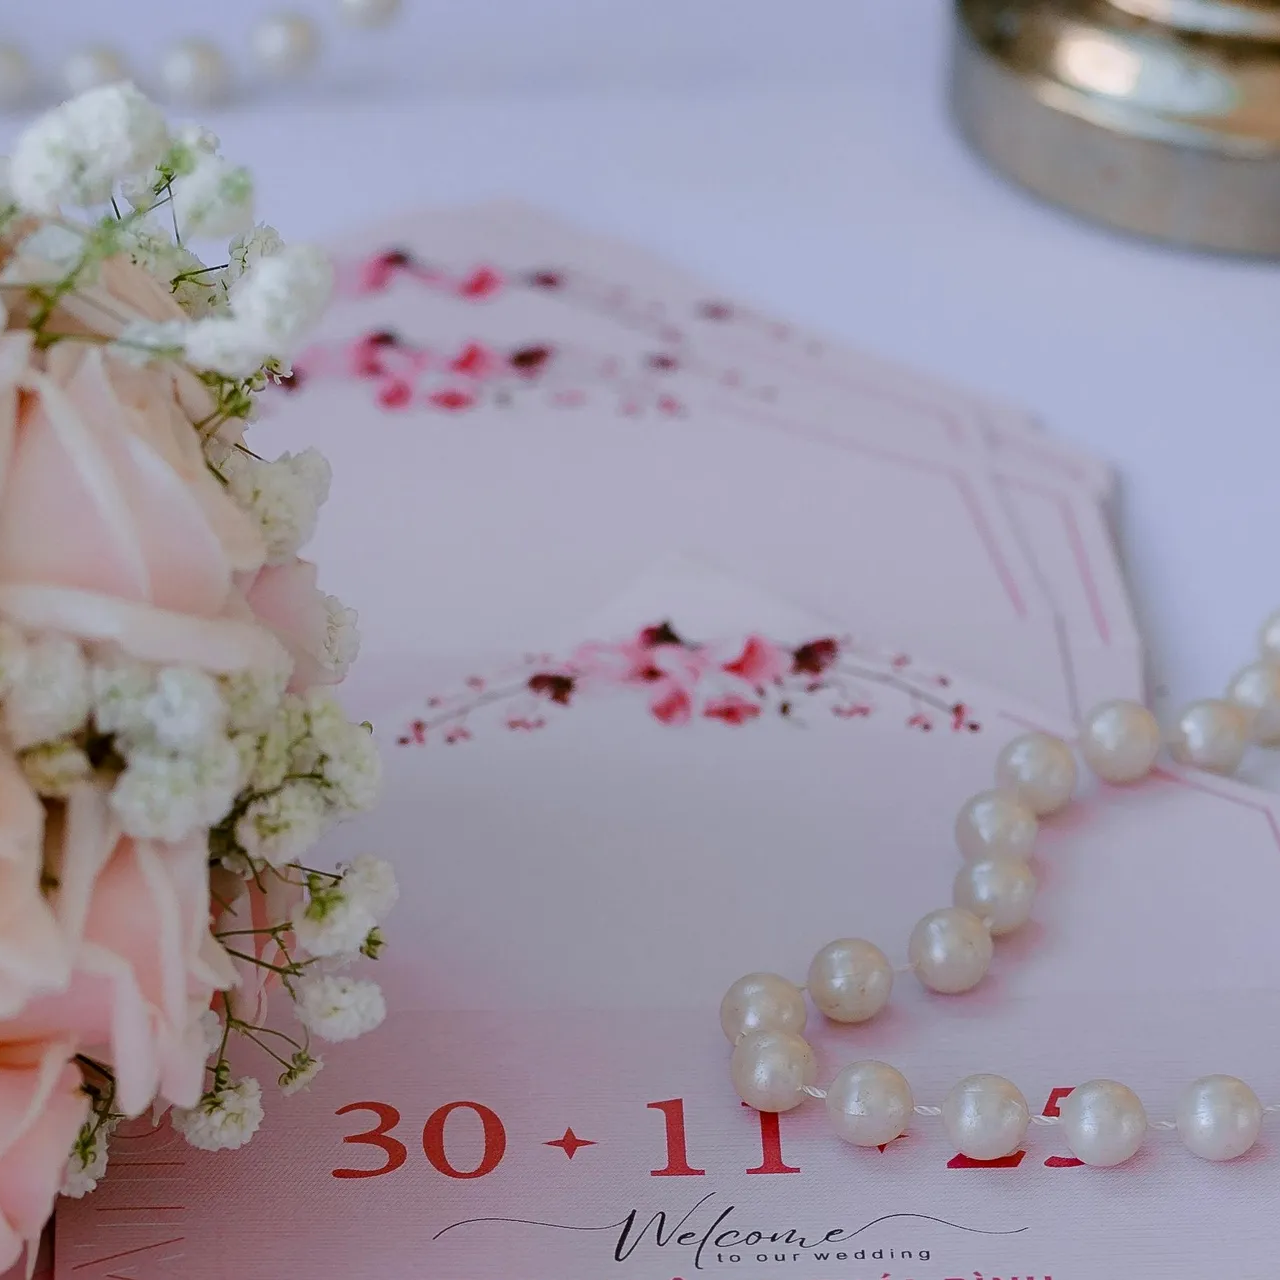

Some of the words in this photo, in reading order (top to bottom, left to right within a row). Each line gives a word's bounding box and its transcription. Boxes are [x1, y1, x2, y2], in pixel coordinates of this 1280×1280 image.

[331, 1100, 508, 1180] 30
[646, 1097, 801, 1177] 11
[613, 1191, 850, 1270] Welcome
[716, 1251, 742, 1263] to
[756, 1252, 801, 1263] our
[813, 1247, 931, 1262] wedding
